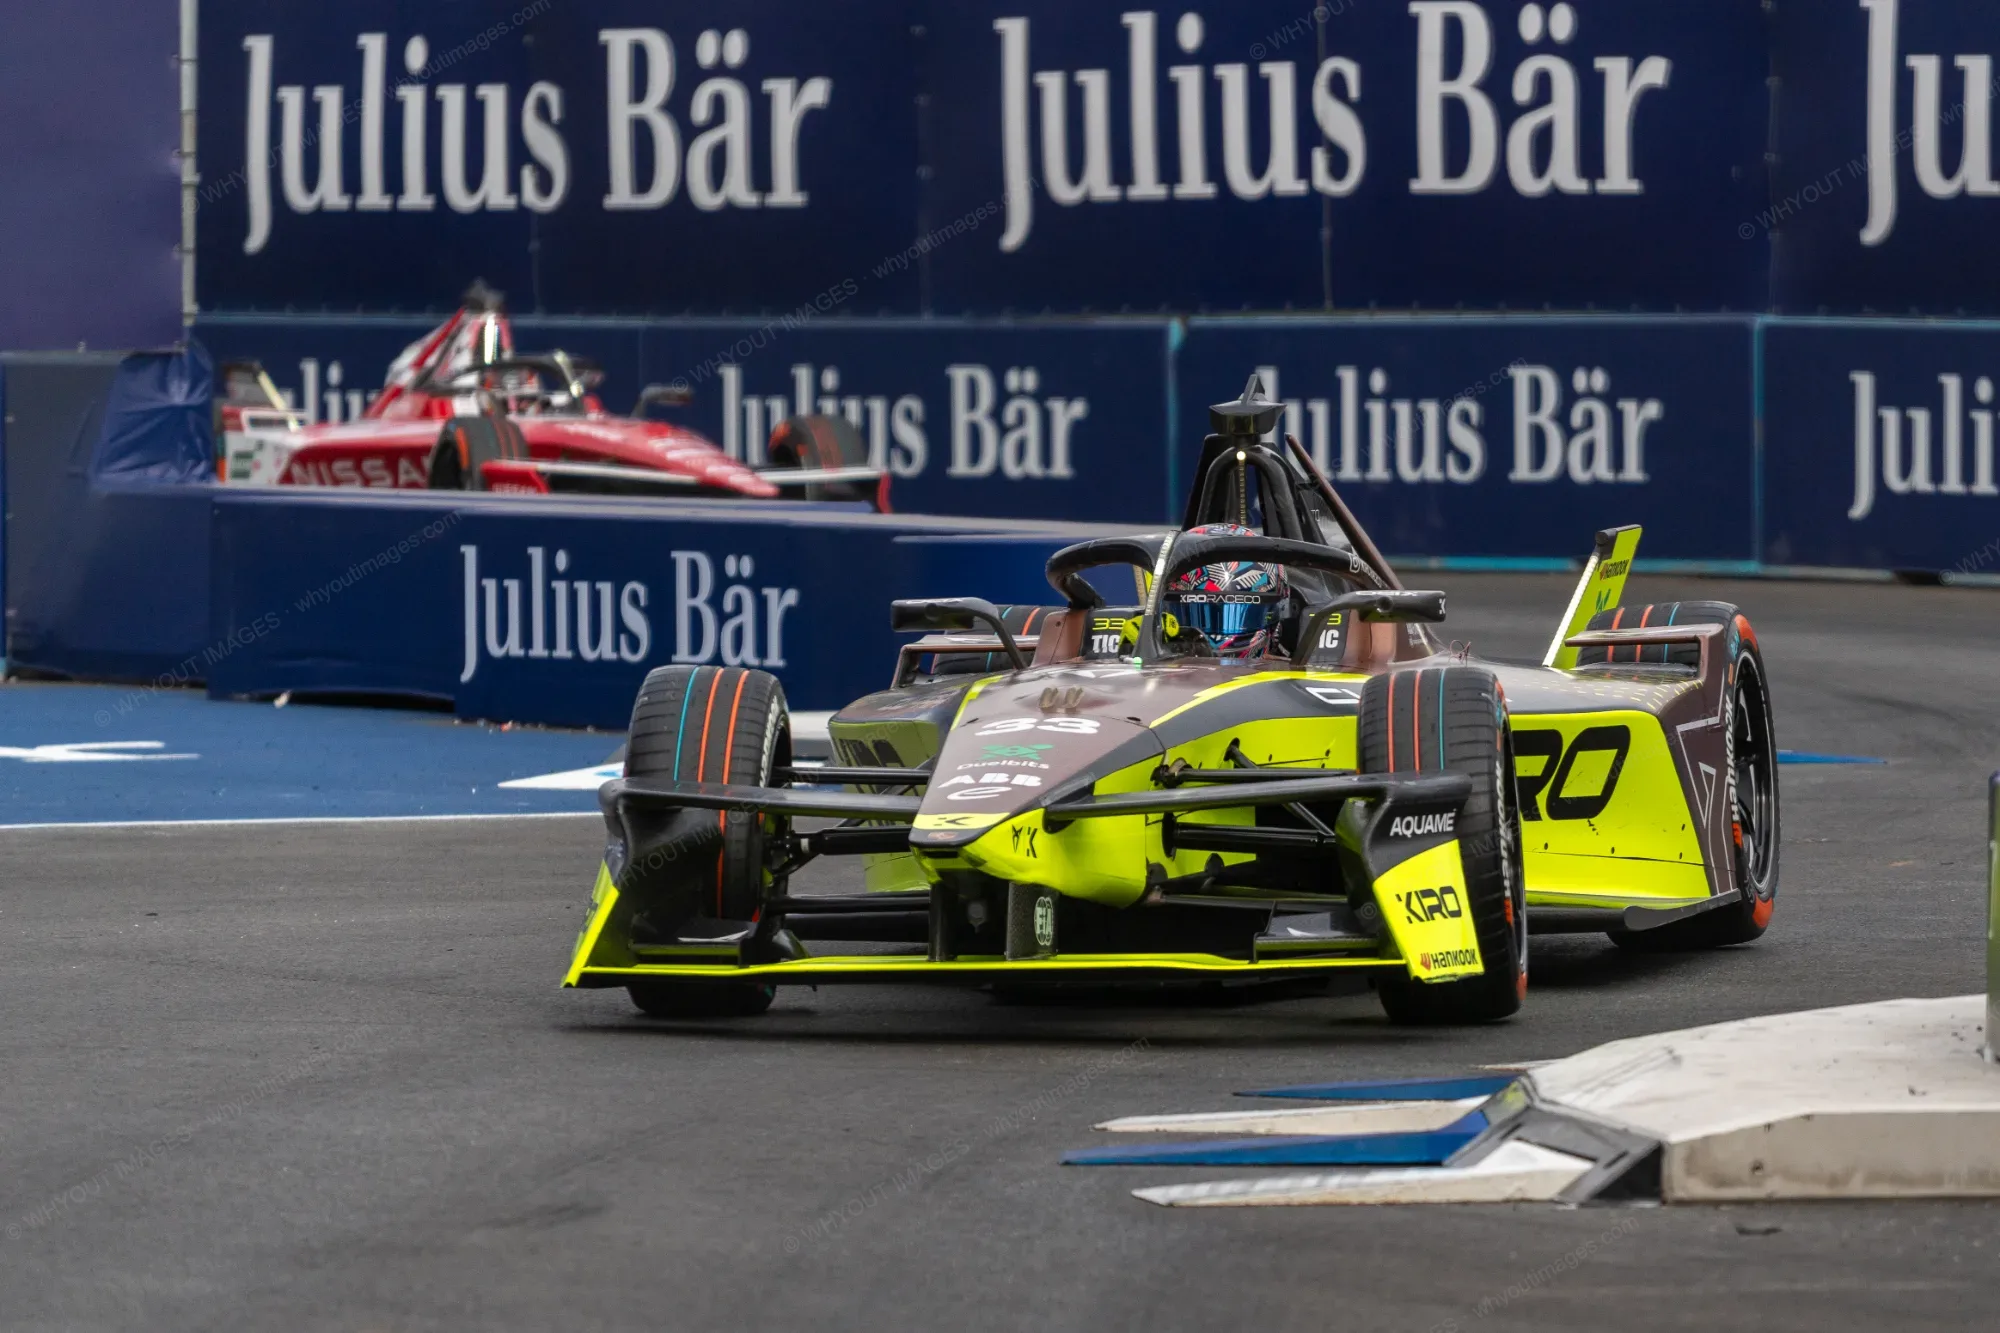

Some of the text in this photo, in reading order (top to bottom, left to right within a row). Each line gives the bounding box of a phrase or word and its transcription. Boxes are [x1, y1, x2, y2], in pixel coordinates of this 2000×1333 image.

[243, 28, 831, 254] Julius Bär
[993, 0, 1670, 252] Julius Bär
[946, 364, 1088, 479] Bär
[1507, 364, 1662, 484] Bär
[1848, 371, 2000, 520] Juli
[290, 455, 433, 487] NISSA
[460, 545, 798, 683] Julius Bär
[1092, 617, 1126, 630] 33
[1318, 629, 1340, 649] IC
[974, 717, 1101, 736] 33
[937, 772, 1042, 787] ABB
[1395, 885, 1463, 924] KIRO
